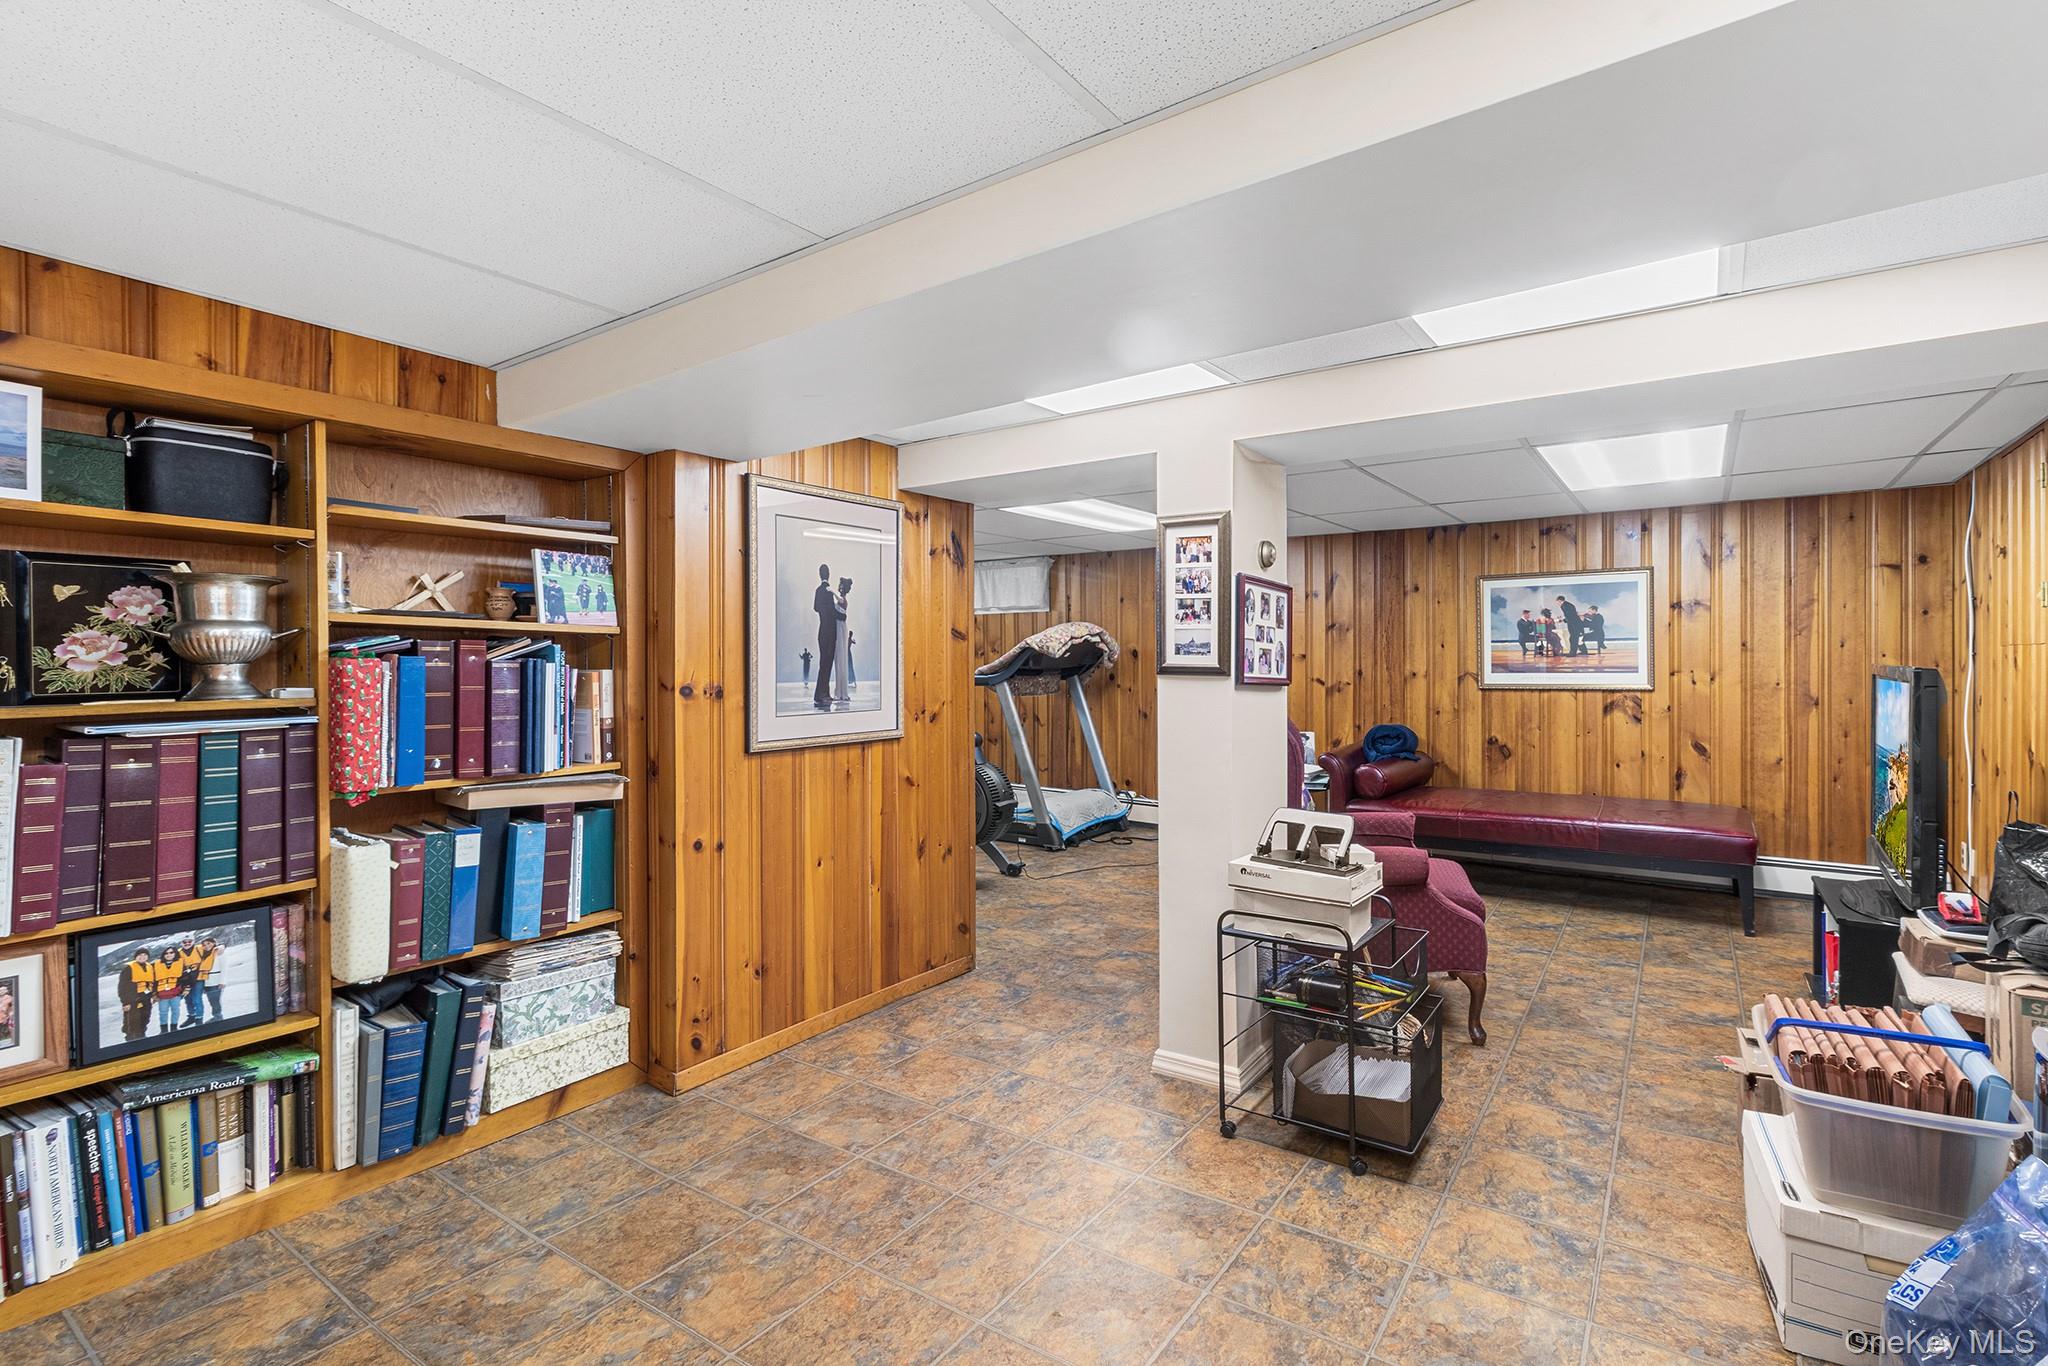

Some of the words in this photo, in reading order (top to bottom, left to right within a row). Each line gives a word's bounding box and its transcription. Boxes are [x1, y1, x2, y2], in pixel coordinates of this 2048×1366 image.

[1240, 867, 1272, 879] UNIVERSAL
[142, 1087, 206, 1106] Americana
[209, 1076, 245, 1091] Roads
[218, 1098, 228, 1141] TESTAMENT
[228, 1113, 239, 1137] NEW
[84, 1128, 101, 1173] speeches
[168, 1141, 176, 1152] Life
[179, 1121, 189, 1160] WILLIAM
[47, 1145, 60, 1174] NORTH
[169, 1161, 178, 1186] Medicine
[181, 1163, 190, 1191] OSLER
[49, 1178, 62, 1223] AMERICAN
[91, 1184, 103, 1205] changed
[96, 1215, 105, 1229] world
[54, 1223, 65, 1249] BIRDS
